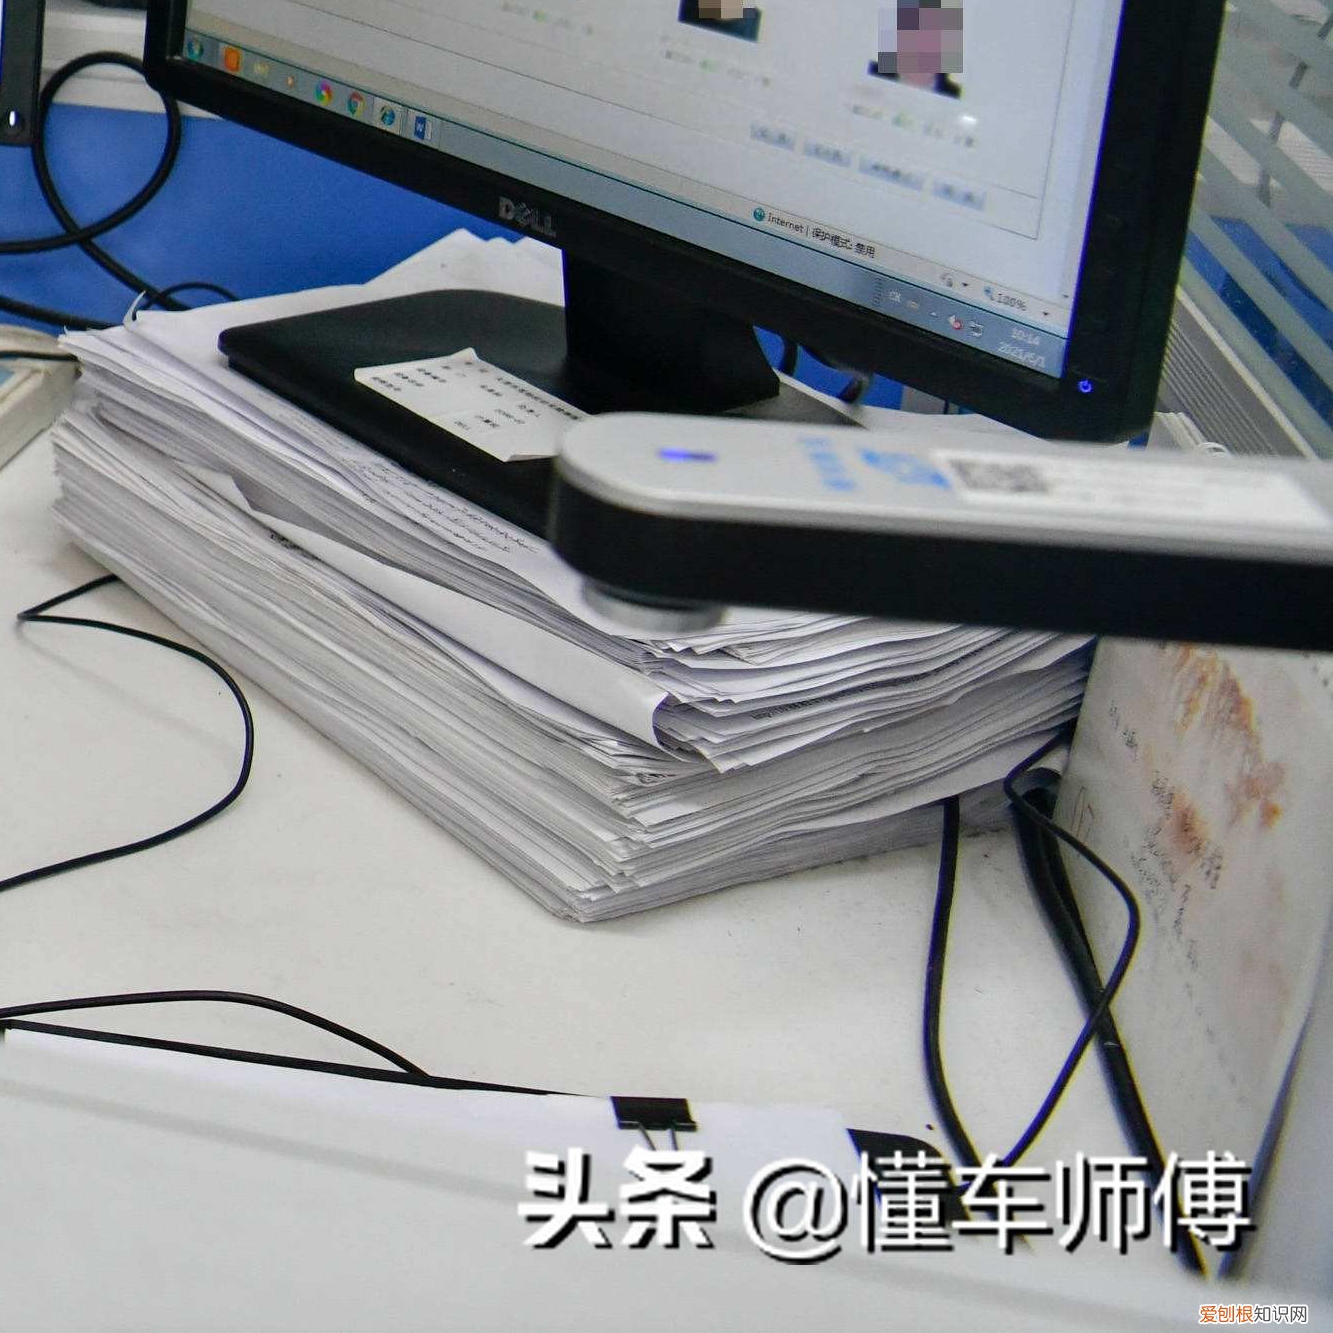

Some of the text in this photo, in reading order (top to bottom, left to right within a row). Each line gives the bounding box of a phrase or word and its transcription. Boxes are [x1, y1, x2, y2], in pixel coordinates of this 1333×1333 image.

[498, 197, 557, 238] DELL
[766, 211, 876, 259] Internet 保护模式: 禁用
[997, 292, 1028, 312] 100%
